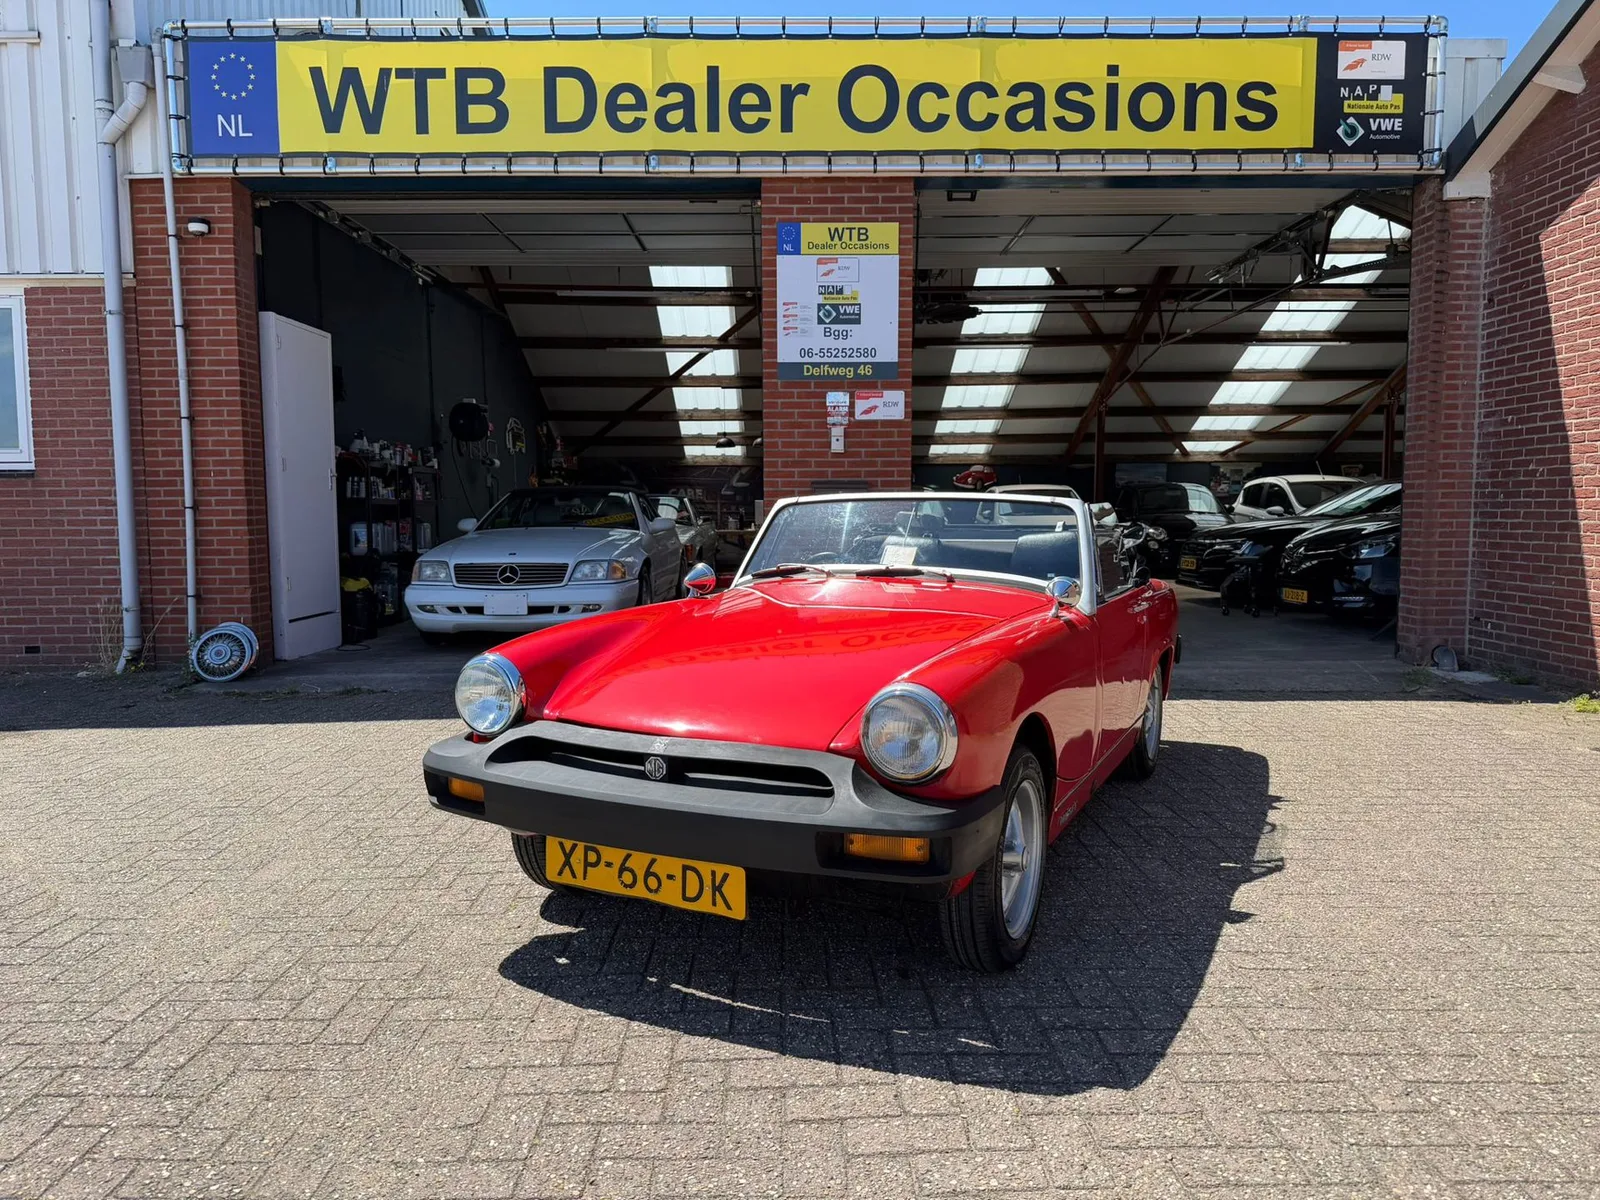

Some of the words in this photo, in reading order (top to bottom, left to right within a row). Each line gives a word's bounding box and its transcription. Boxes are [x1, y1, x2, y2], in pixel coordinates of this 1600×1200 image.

[1371, 53, 1392, 61] RDW
[308, 66, 510, 136] WTB
[544, 65, 810, 135] Dealer
[837, 64, 1279, 134] Occasions
[217, 113, 253, 138] NL
[1369, 118, 1403, 131] VWE
[828, 227, 869, 242] WTB
[807, 241, 838, 250] Dealer
[840, 241, 890, 250] Occasions
[838, 305, 860, 314] VWE
[823, 326, 853, 340] Bgg:
[799, 347, 877, 358] 06-55252580
[803, 364, 854, 378] Delfweg
[857, 364, 873, 376] 46
[882, 400, 899, 408] RDW
[646, 758, 664, 778] MG
[557, 841, 732, 911] XP-66-DK
